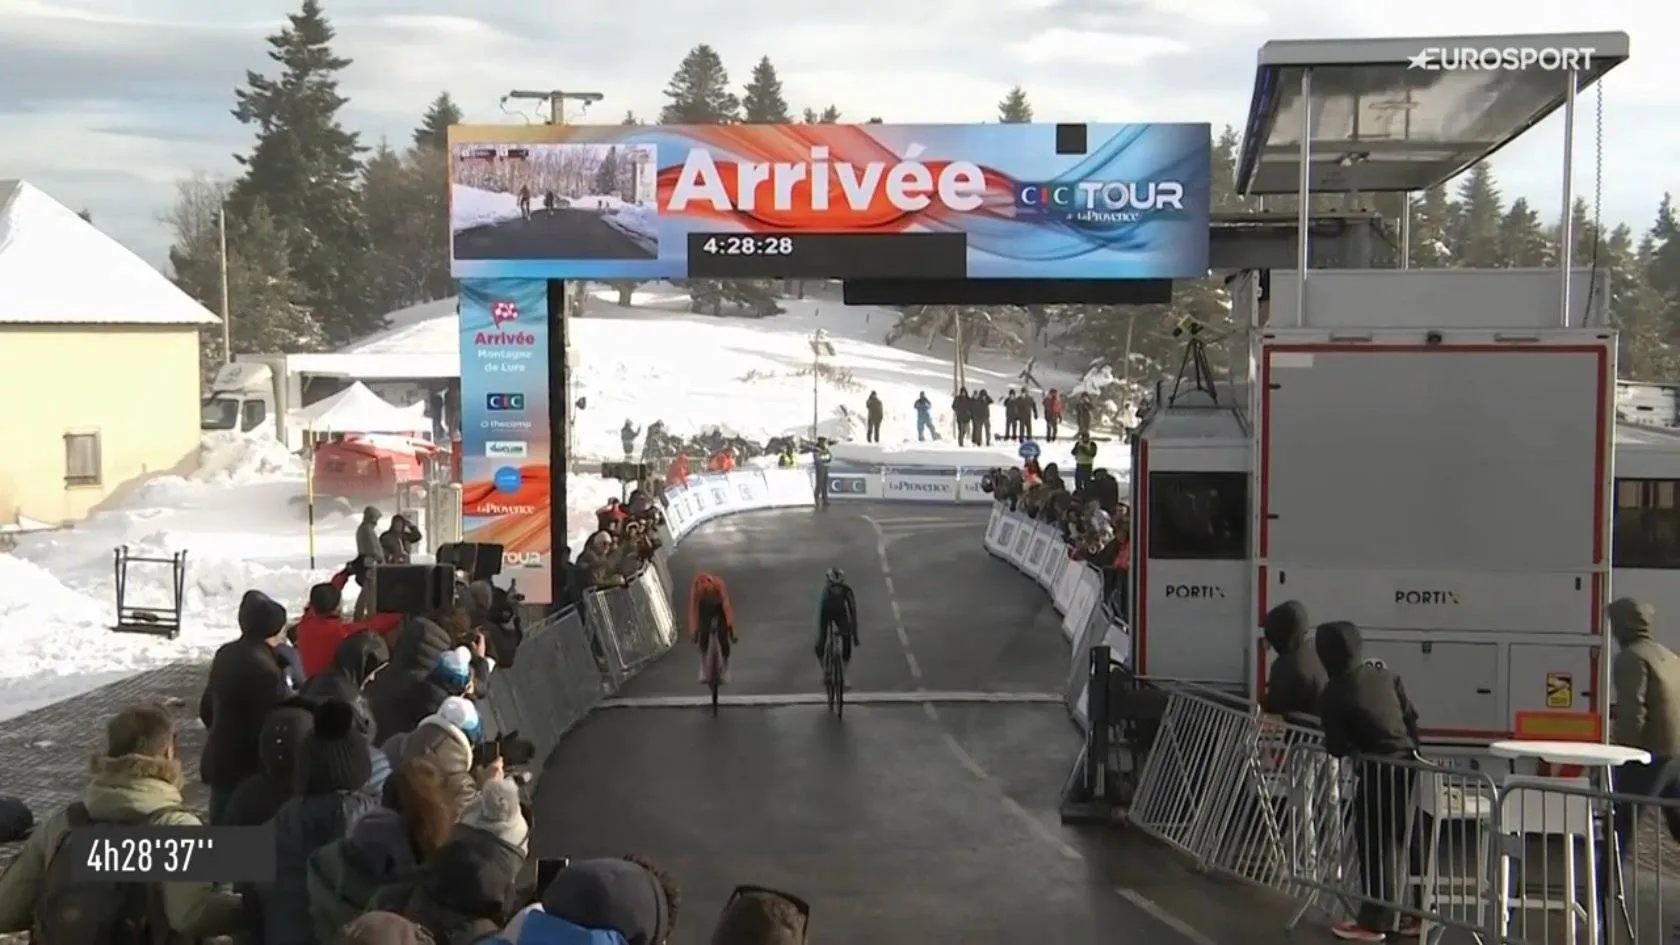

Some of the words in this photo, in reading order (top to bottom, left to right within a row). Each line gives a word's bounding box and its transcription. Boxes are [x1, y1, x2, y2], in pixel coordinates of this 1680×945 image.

[667, 142, 987, 212] Arrivée
[1020, 186, 1069, 206] CIC
[1078, 181, 1185, 210] TOUR
[702, 237, 794, 256] 4:28:28
[474, 330, 536, 346] Arrivée
[477, 349, 533, 360] Montagne
[484, 362, 499, 373] de
[501, 362, 527, 373] Lure
[489, 395, 522, 408] CIC
